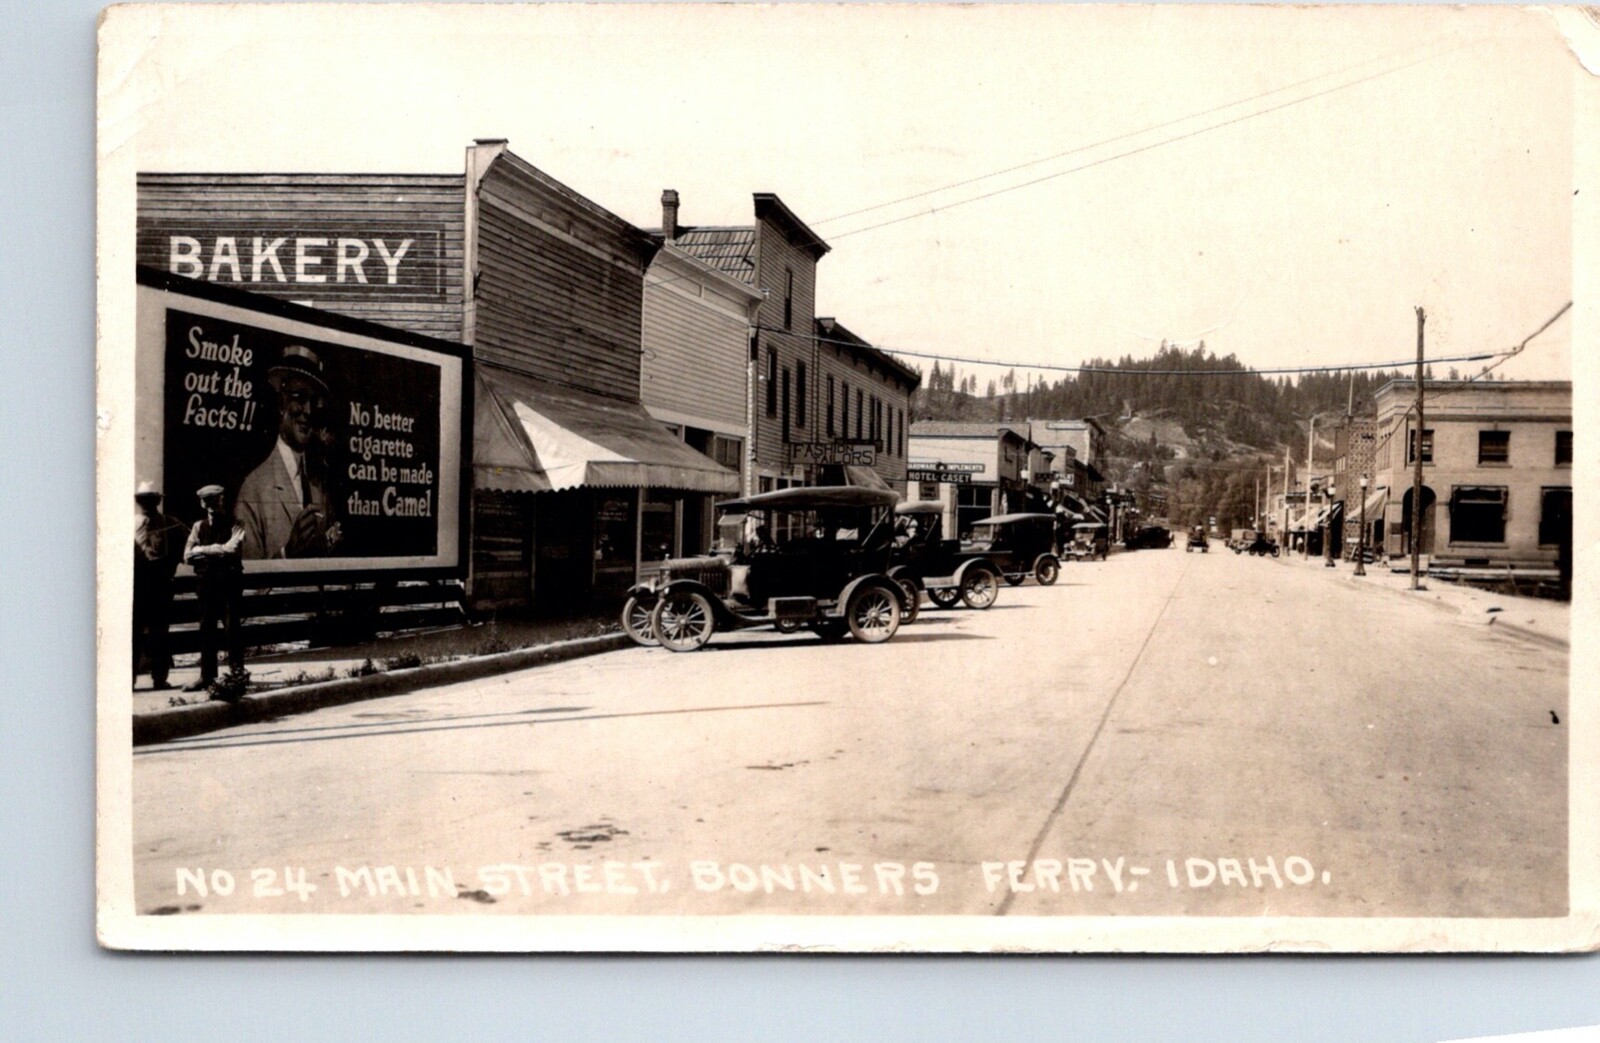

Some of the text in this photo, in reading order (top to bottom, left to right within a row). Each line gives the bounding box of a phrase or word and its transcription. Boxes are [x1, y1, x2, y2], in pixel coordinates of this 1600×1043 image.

[169, 235, 415, 285] BAKERY
[185, 326, 253, 367] Smoke
[184, 367, 253, 399] out the
[349, 401, 415, 432] No better
[349, 430, 414, 461] cigarette
[793, 443, 854, 458] FASHION
[813, 450, 873, 465] TAILORS
[348, 459, 433, 484] can be made
[909, 471, 970, 483] HOTEL CASEY
[347, 486, 432, 517] than Camel
